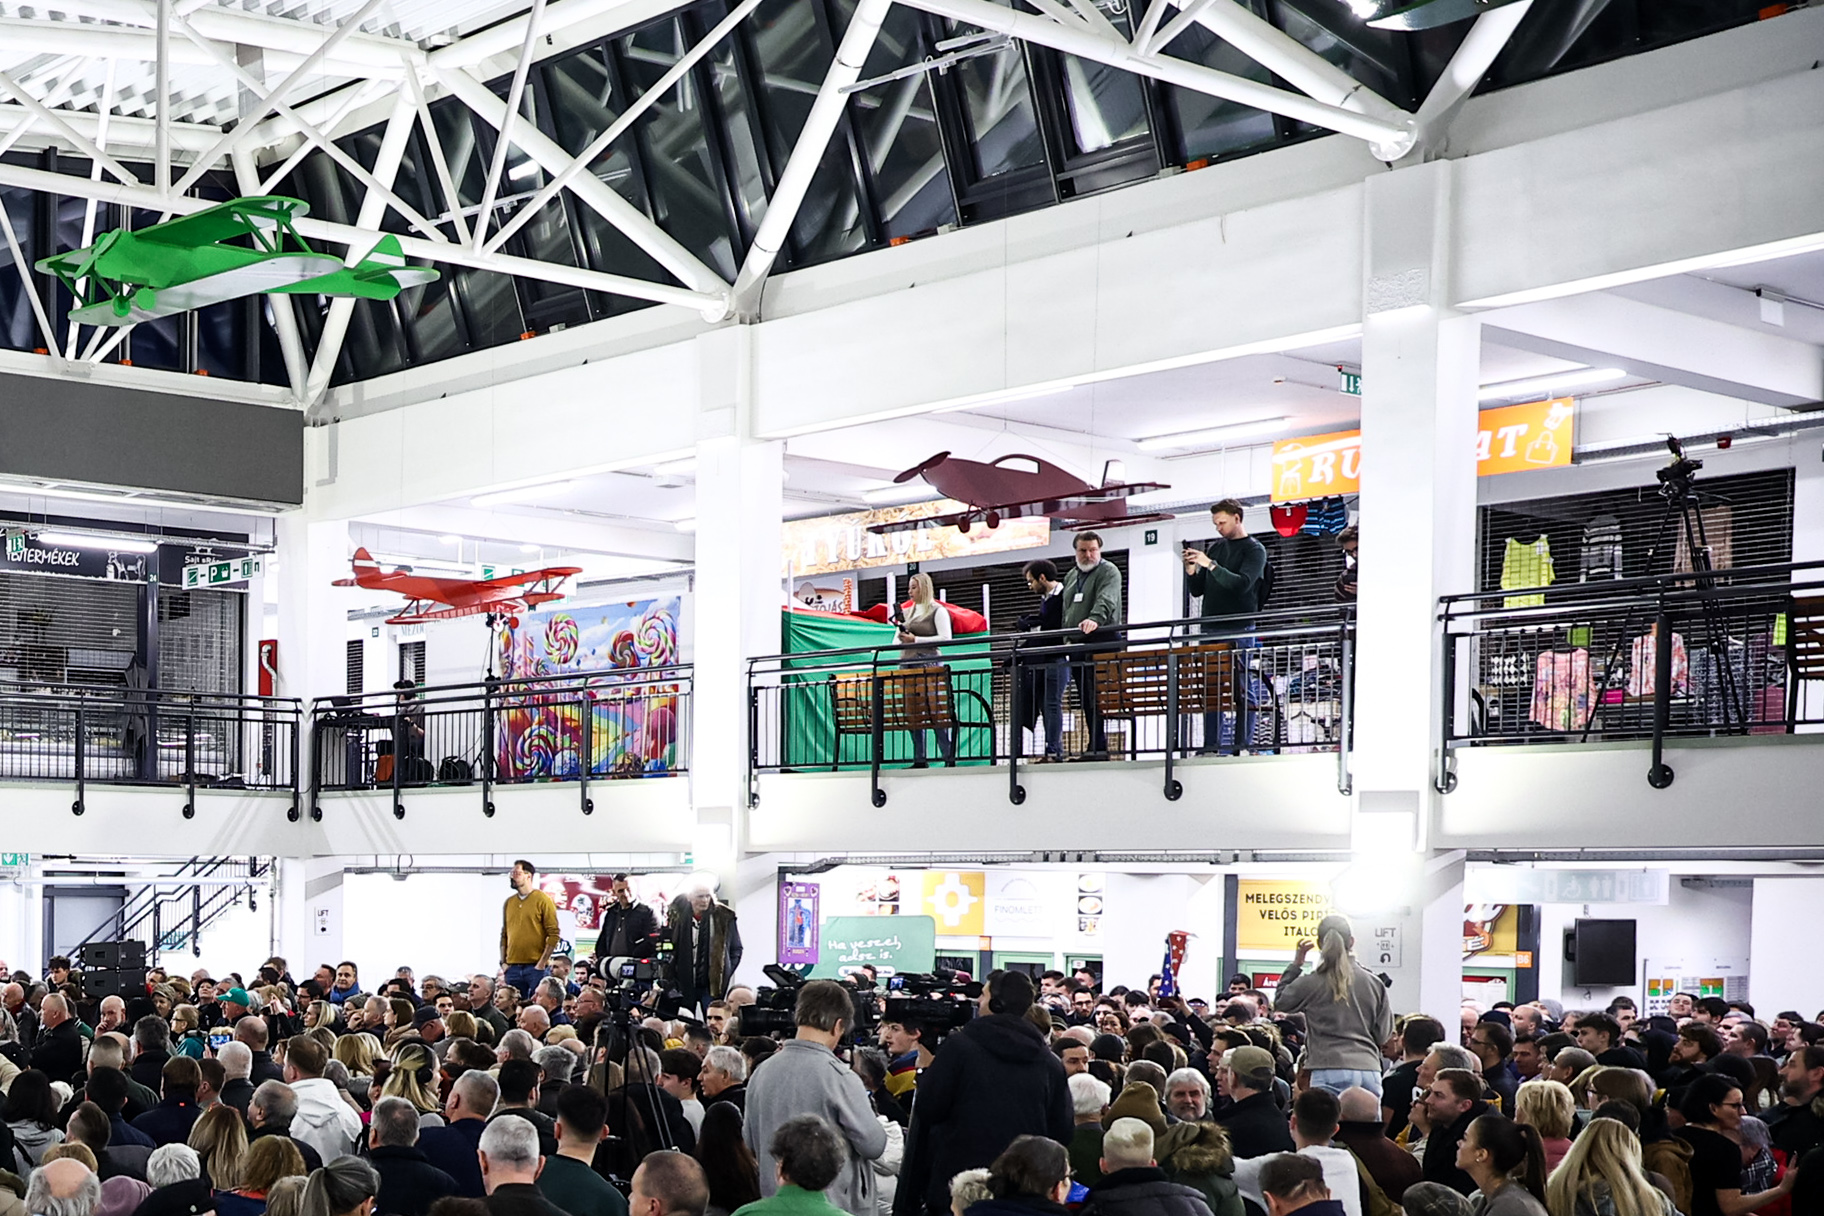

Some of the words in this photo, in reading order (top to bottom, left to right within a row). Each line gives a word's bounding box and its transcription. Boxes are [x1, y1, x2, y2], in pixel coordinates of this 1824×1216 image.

[1147, 532, 1156, 542] 19
[149, 574, 157, 583] 24
[1245, 893, 1332, 904] MELEGSZENDV
[1259, 907, 1297, 920] VELŐS
[1375, 928, 1396, 938] LIFT
[828, 940, 847, 950] Ha
[838, 949, 876, 962] adsz
